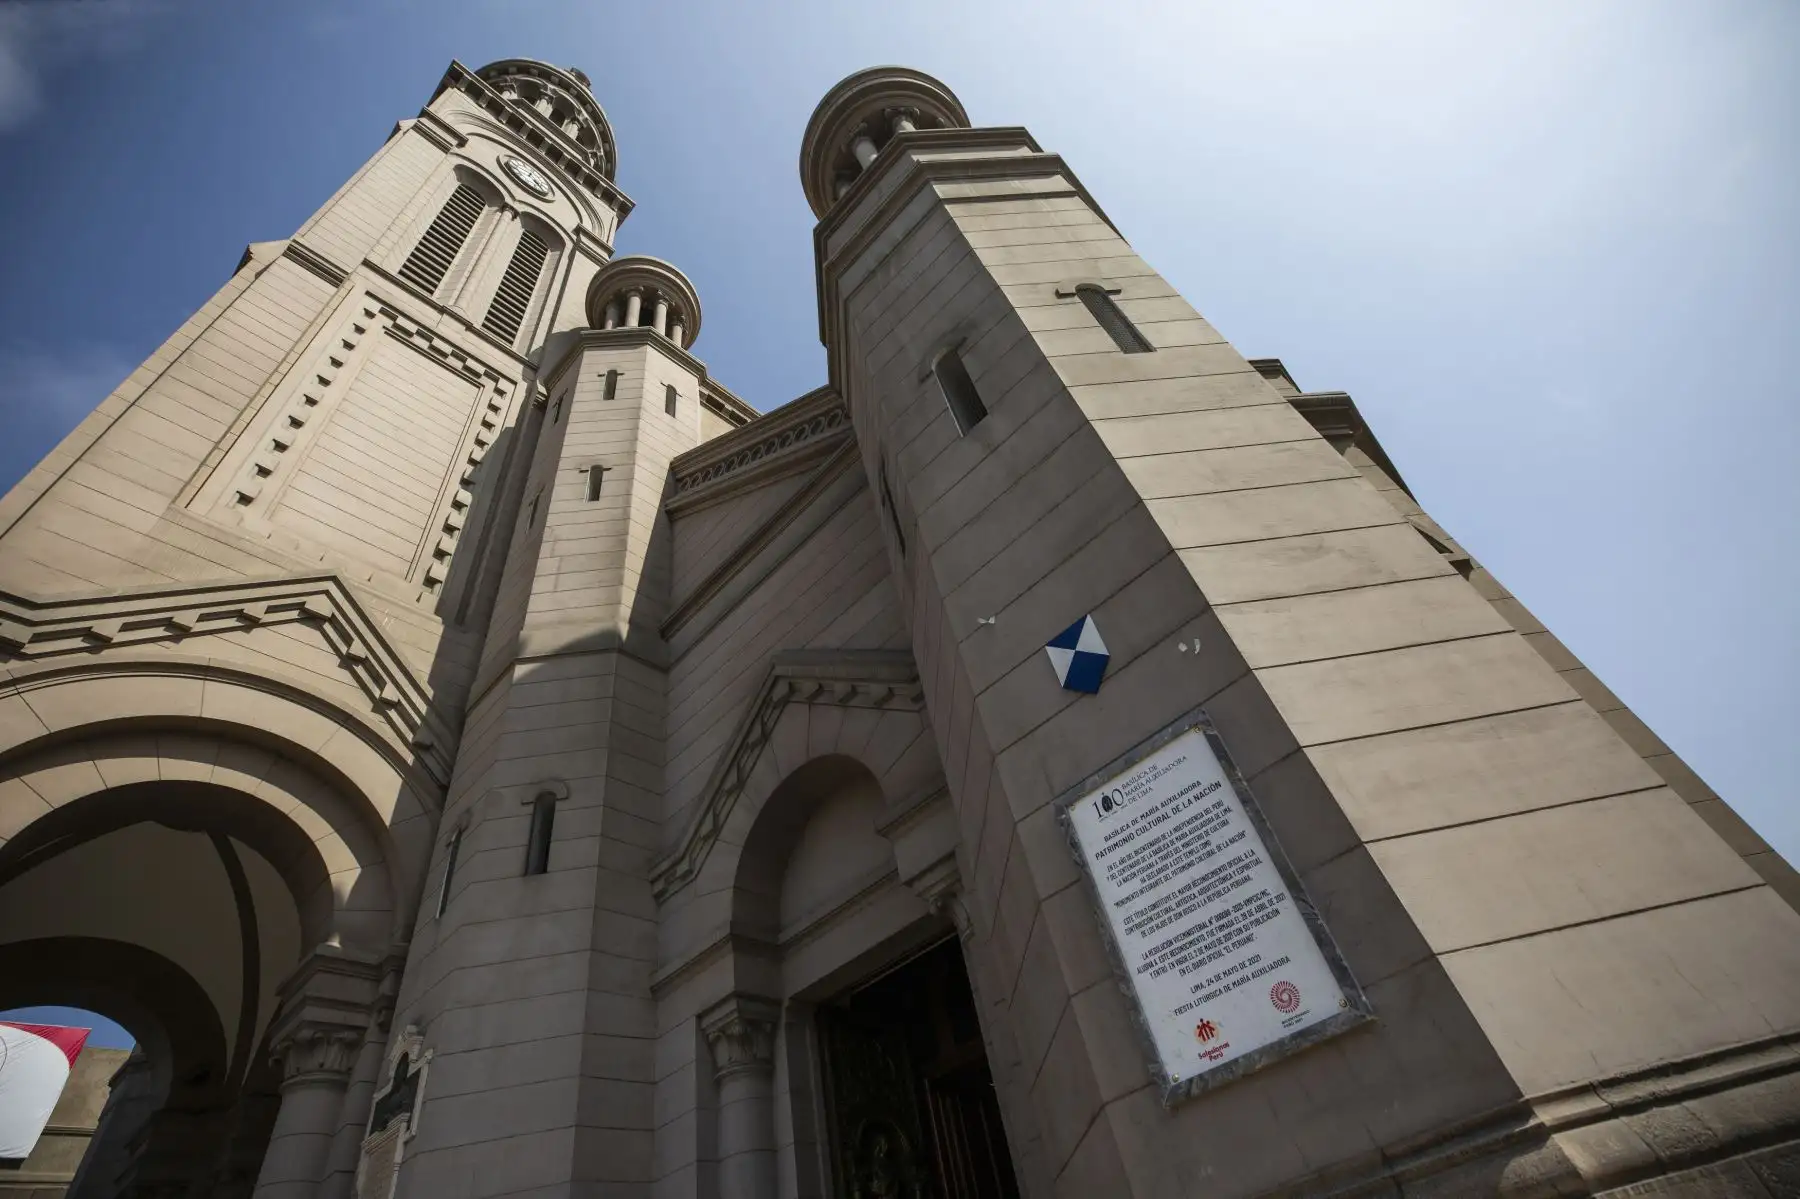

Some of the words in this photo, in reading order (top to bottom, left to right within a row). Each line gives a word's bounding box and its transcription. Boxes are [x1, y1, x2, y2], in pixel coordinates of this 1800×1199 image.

[1137, 786, 1153, 799] LIMA
[1145, 755, 1188, 785] AUXILIADORA
[1095, 832, 1135, 860] PATRIMONIO
[1135, 811, 1172, 837] CULTURAL
[1171, 804, 1183, 815] DE
[1182, 798, 1194, 809] LA
[1193, 781, 1222, 803] NACIÓN
[1130, 816, 1140, 826] DE
[1139, 805, 1160, 821] MARÍA
[1159, 780, 1202, 809] AUXILIADORA
[1109, 872, 1118, 881] DEL
[1117, 858, 1141, 876] CENTENARIO
[1188, 816, 1215, 836] AUXILIADORA
[1126, 852, 1134, 861] DEL
[1133, 836, 1162, 857] BICENTENARIO
[1172, 811, 1205, 834] INDEPENDENCIA
[1203, 807, 1212, 816] DEL
[1136, 861, 1155, 876] PERUANA
[1173, 845, 1182, 855] DEL
[1181, 832, 1205, 850] MINISTERIO
[1209, 818, 1230, 834] CULTURA
[1138, 877, 1163, 896] INTEGRANTE
[1163, 873, 1171, 882] DEL
[1171, 859, 1196, 878] PATRIMONIO
[1194, 847, 1218, 865] CULTURAL
[1146, 863, 1170, 881] DECLARADO
[1172, 855, 1184, 866] ESTE
[1183, 846, 1200, 860] TEMPLO
[1199, 840, 1212, 851] COMO
[1123, 915, 1134, 925] ESTE
[1147, 894, 1172, 912] CONSTITUYE
[1177, 883, 1193, 896] MAYOR
[1191, 864, 1228, 888] RECONOCIMIENTO
[1227, 855, 1245, 869] OFICIAL
[1136, 960, 1154, 975] ALUSIVA
[1158, 952, 1170, 963] ESTE
[1205, 928, 1216, 939] FUE
[1214, 918, 1236, 934] FIRMADA
[1253, 902, 1268, 914] ABRIL
[1274, 892, 1287, 904] 2021
[1146, 925, 1156, 935] LOS
[1154, 919, 1168, 931] HIJOS
[1173, 910, 1184, 921] DON
[1182, 903, 1198, 916] BOSCO
[1172, 920, 1209, 944] VICEMINISTERIAL
[1174, 954, 1189, 967] VIGOR
[1203, 940, 1217, 952] MAYO
[1222, 931, 1234, 943] 2021
[1232, 926, 1244, 938] CON
[1191, 957, 1208, 971] DIARIO
[1206, 949, 1224, 963] OFICIAL
[1174, 1001, 1194, 1016] FIESTA
[1223, 983, 1232, 993] DE
[1231, 974, 1252, 989] MARÍA
[1250, 955, 1291, 980] AUXILIADORA
[1190, 981, 1206, 994] LIMA,
[1205, 977, 1215, 987] 24
[1214, 973, 1223, 983] DE
[1222, 965, 1240, 979] MAYO
[1238, 961, 1248, 971] DE
[1247, 954, 1262, 967] 2021
